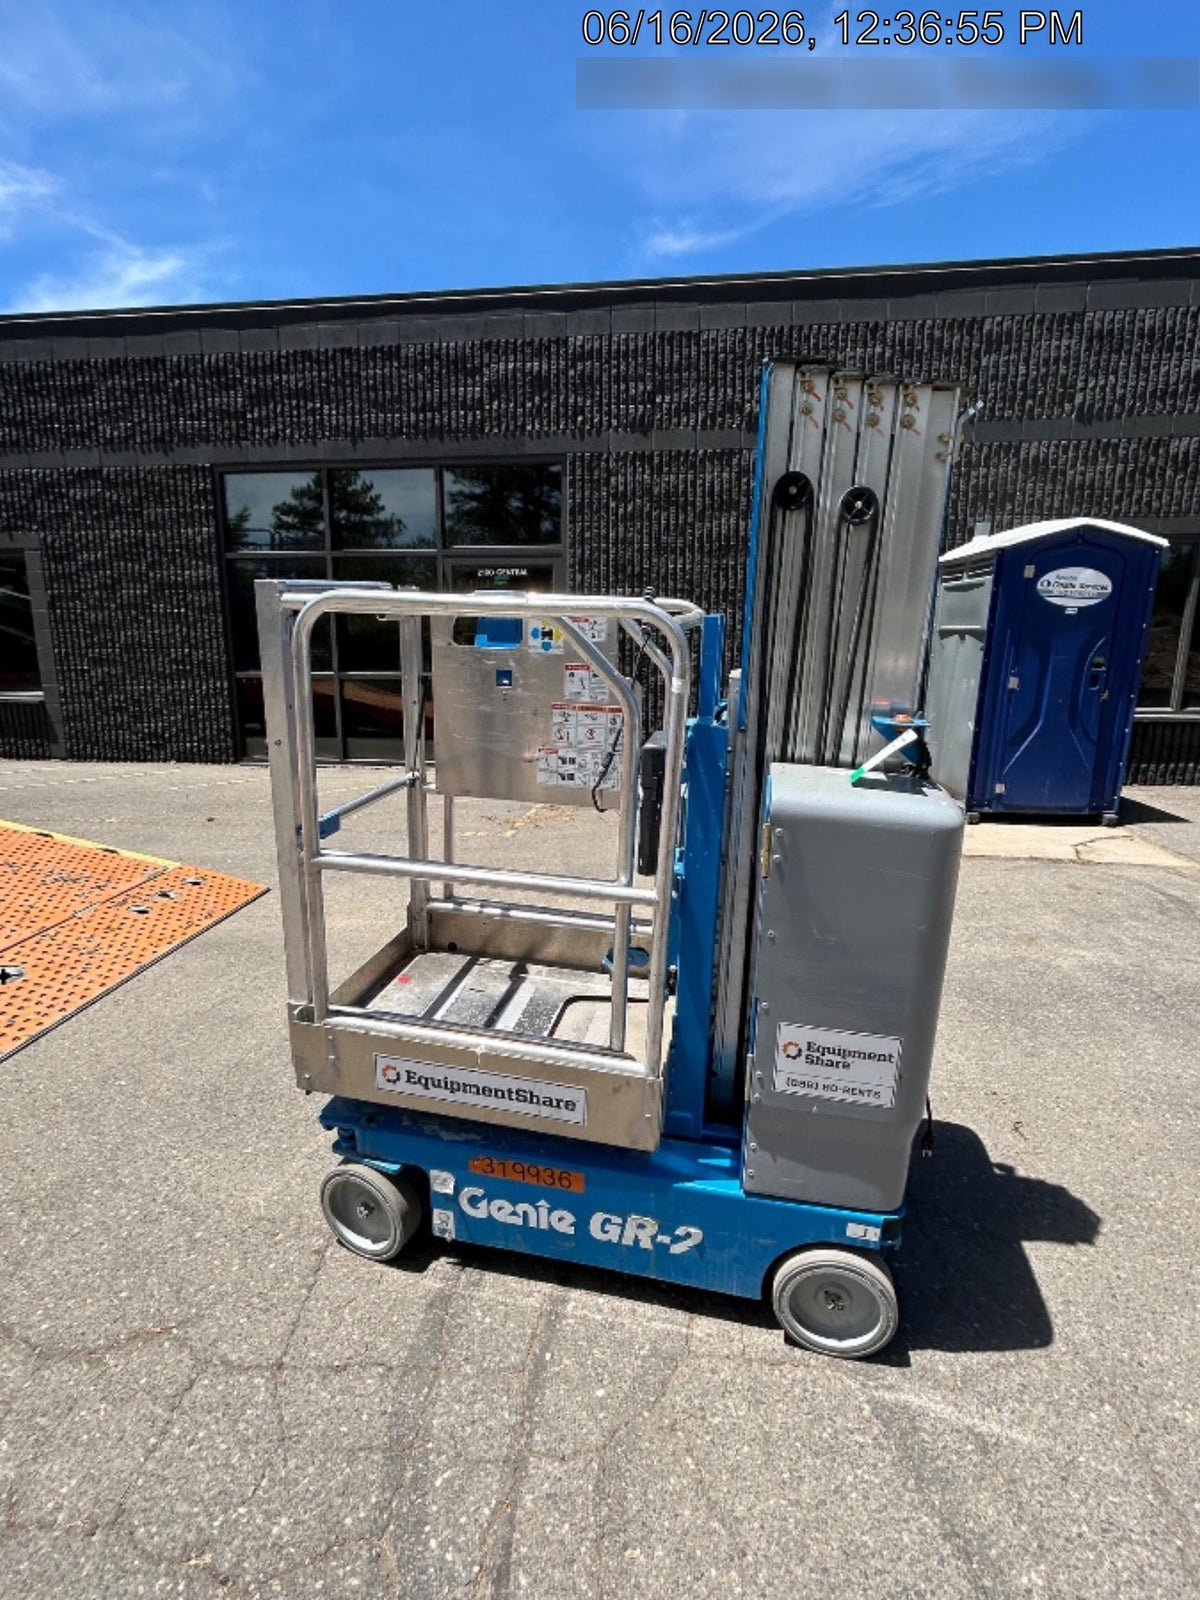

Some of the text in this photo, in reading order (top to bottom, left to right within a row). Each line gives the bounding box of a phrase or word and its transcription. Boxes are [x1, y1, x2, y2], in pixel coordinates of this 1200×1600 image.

[804, 1053, 851, 1070] Share
[806, 1041, 895, 1064] Equipment
[404, 1069, 577, 1112] EquipmentShare
[481, 1155, 573, 1190] 319936
[458, 1186, 577, 1235] Genie
[588, 1211, 703, 1254] GR-2
